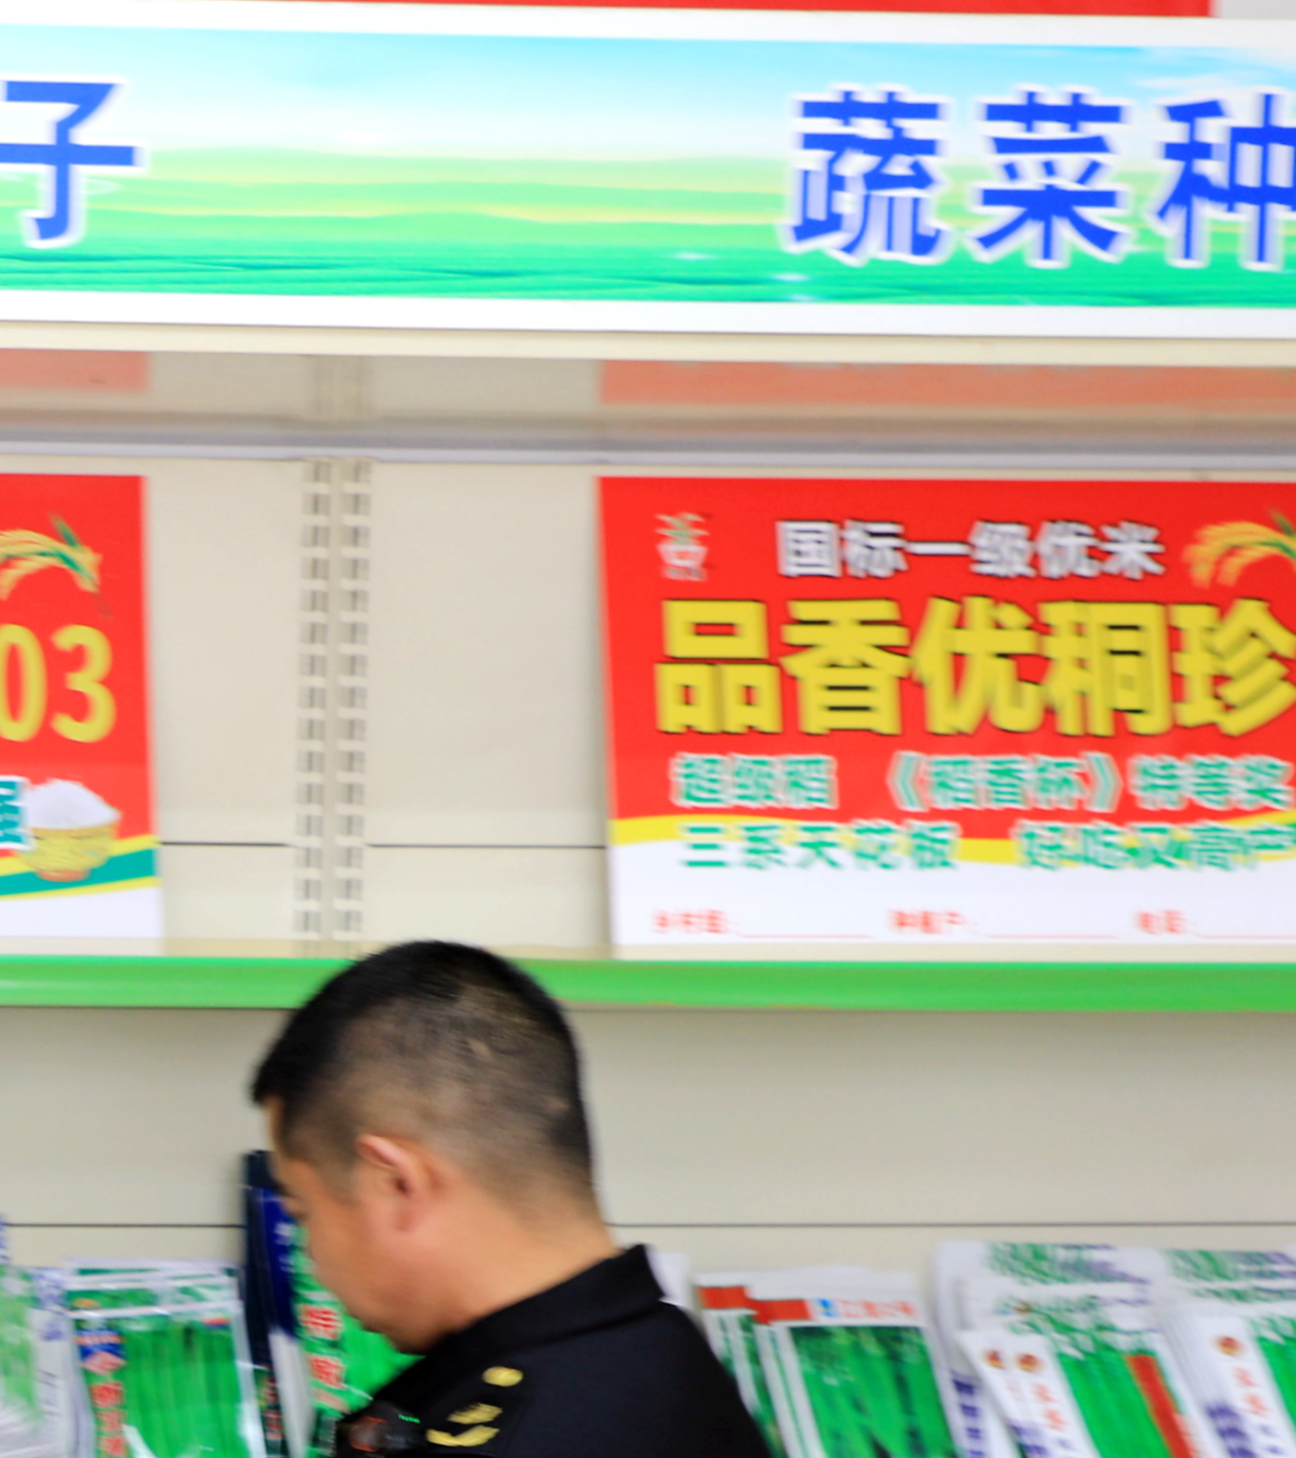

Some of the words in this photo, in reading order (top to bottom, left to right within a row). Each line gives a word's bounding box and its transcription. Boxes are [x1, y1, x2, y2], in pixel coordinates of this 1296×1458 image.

[787, 88, 1296, 265] 蔬菜种
[777, 521, 1167, 579] 国标一级优米
[670, 753, 837, 809] 超级稻
[1129, 754, 1296, 812] 特等奖
[680, 821, 959, 870] 三系天花板
[1015, 820, 1296, 872] 好吃又高产
